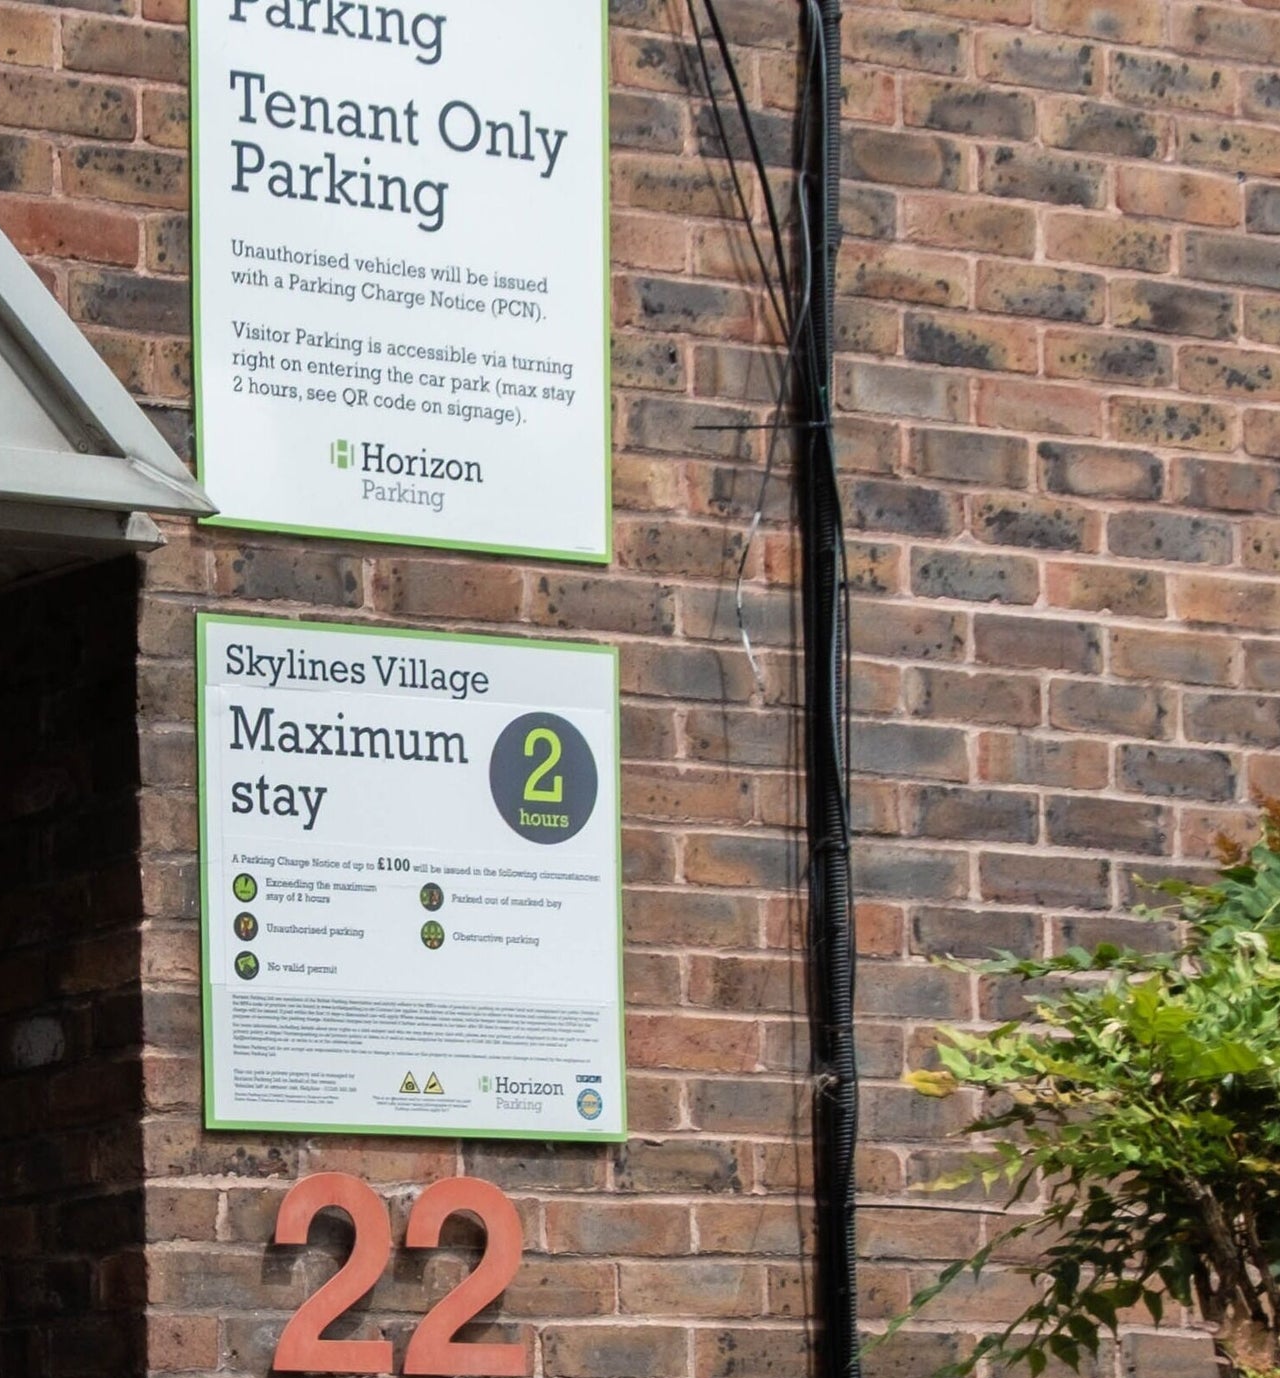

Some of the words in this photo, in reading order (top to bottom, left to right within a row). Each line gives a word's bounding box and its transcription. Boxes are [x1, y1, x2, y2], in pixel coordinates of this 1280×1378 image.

[230, 70, 419, 146] Tenant
[439, 100, 567, 179] Only
[231, 140, 448, 232] Parking
[231, 240, 350, 270] Unauthorised
[354, 256, 426, 280] vehicles
[431, 265, 461, 284] will
[467, 269, 489, 288] be
[493, 272, 548, 294] issued
[231, 269, 268, 289] with
[274, 278, 284, 289] a
[289, 274, 356, 302] Parking
[361, 282, 425, 307] Charge
[430, 291, 485, 313] Notice
[490, 298, 547, 321] (PCN).
[232, 320, 290, 344] Visitor
[295, 328, 363, 356] Parking
[368, 337, 382, 354] is
[387, 338, 476, 365] accessible
[482, 351, 508, 369] via
[512, 354, 574, 379] turning
[232, 349, 275, 373] right
[281, 360, 302, 373] on
[307, 359, 382, 385] entering
[387, 366, 413, 385] the
[419, 373, 446, 388] car
[451, 373, 490, 395] park
[495, 378, 537, 399] (max
[543, 385, 575, 406] stay
[233, 376, 243, 392] 2
[248, 377, 303, 402] hours,
[307, 388, 337, 403] see
[342, 387, 369, 408] QR
[373, 392, 416, 412] code
[421, 400, 442, 415] on
[447, 401, 527, 426] signage).
[361, 443, 484, 482] Horizon
[361, 480, 445, 512] Parking
[226, 643, 365, 687] Skylines
[372, 655, 489, 699] Village
[229, 705, 468, 764] Maximum
[523, 728, 562, 802] 2
[231, 774, 327, 830] stay
[520, 807, 569, 828] hours
[232, 854, 239, 863] A
[241, 854, 275, 867] Parking
[277, 856, 310, 868] Charge
[312, 858, 340, 869] Notice
[342, 860, 351, 869] of
[353, 862, 364, 872] up
[366, 862, 375, 870] to
[377, 857, 410, 871] £100
[413, 864, 428, 873] will
[430, 864, 442, 874] be
[443, 866, 471, 876] issued
[473, 867, 482, 876] in
[483, 867, 497, 877] the
[498, 868, 538, 880] following
[266, 877, 314, 891] Exceeding
[317, 881, 330, 890] the
[333, 883, 377, 892] maximum
[266, 894, 284, 903] stay
[287, 892, 295, 902] of
[297, 893, 303, 902] 2
[305, 893, 330, 903] hours
[451, 893, 483, 904] Parked
[485, 896, 498, 905] out
[500, 895, 509, 906] of
[511, 897, 543, 907] marked
[546, 898, 562, 909] bay
[266, 923, 327, 935] Unauthorised
[330, 926, 364, 938] parking
[452, 931, 503, 943] Obstructive
[506, 934, 540, 947] parking
[268, 961, 280, 971] No
[284, 962, 305, 973] valid
[307, 965, 337, 975] permit
[495, 1077, 564, 1095] Horizon
[496, 1097, 542, 1113] Parking
[273, 1171, 527, 1376] 22
